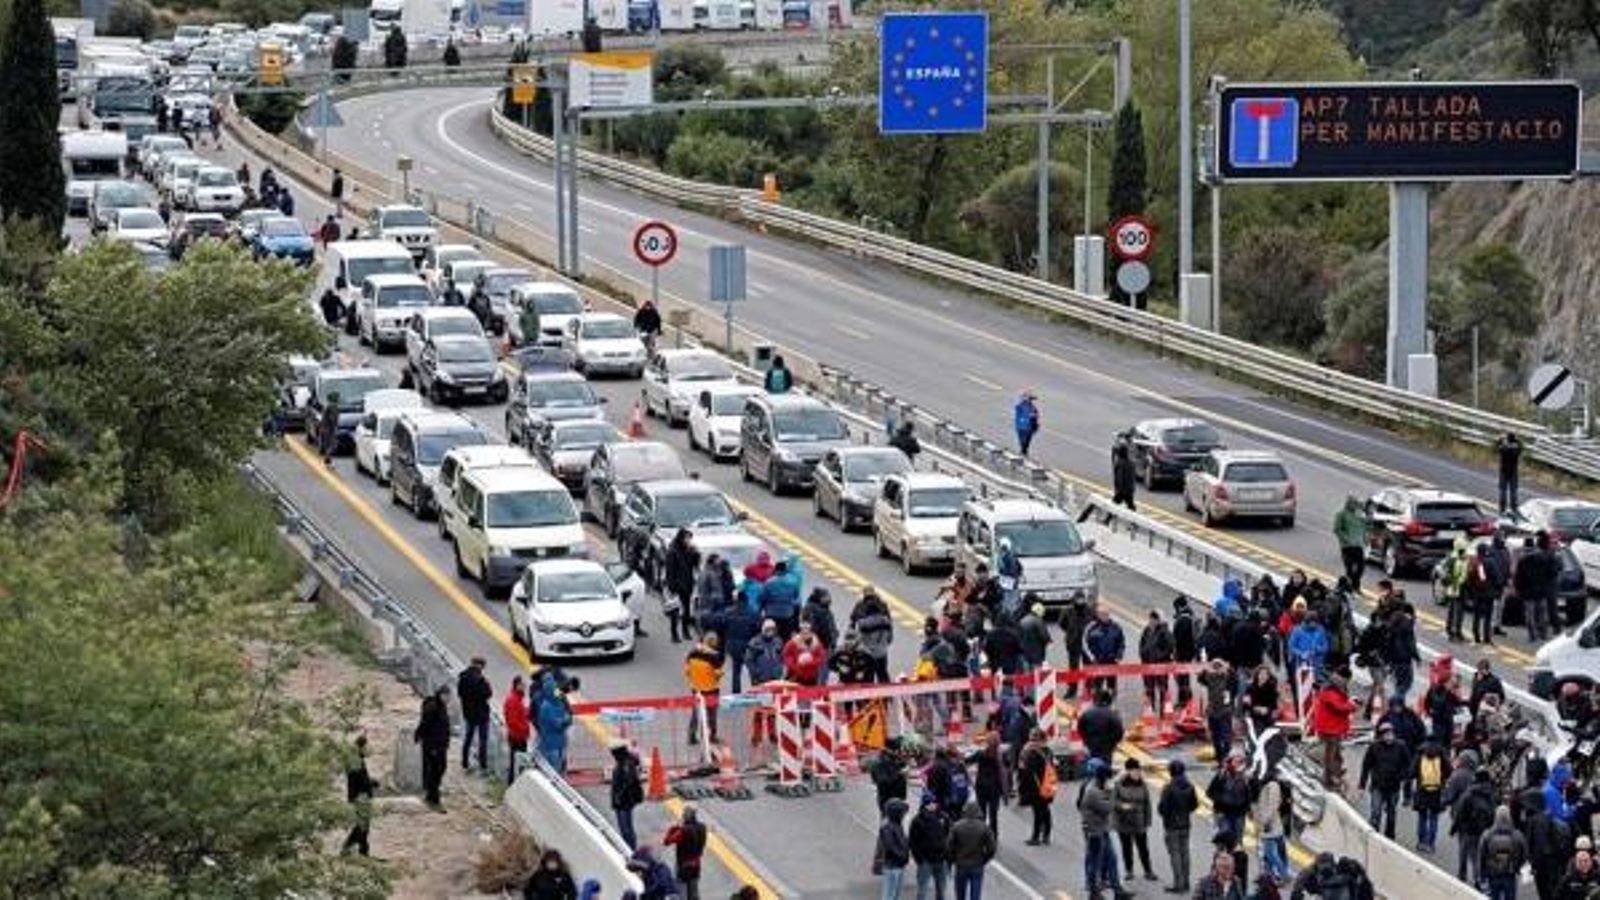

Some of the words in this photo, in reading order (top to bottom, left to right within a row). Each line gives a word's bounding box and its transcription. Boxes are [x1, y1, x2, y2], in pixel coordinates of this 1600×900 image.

[906, 65, 960, 80] ESPAÑA
[1302, 97, 1349, 116] AP7
[1368, 95, 1480, 117] TALLADA
[1301, 122, 1348, 142] PER
[1366, 120, 1562, 141] MANIFESTACIO
[1119, 231, 1147, 246] 100
